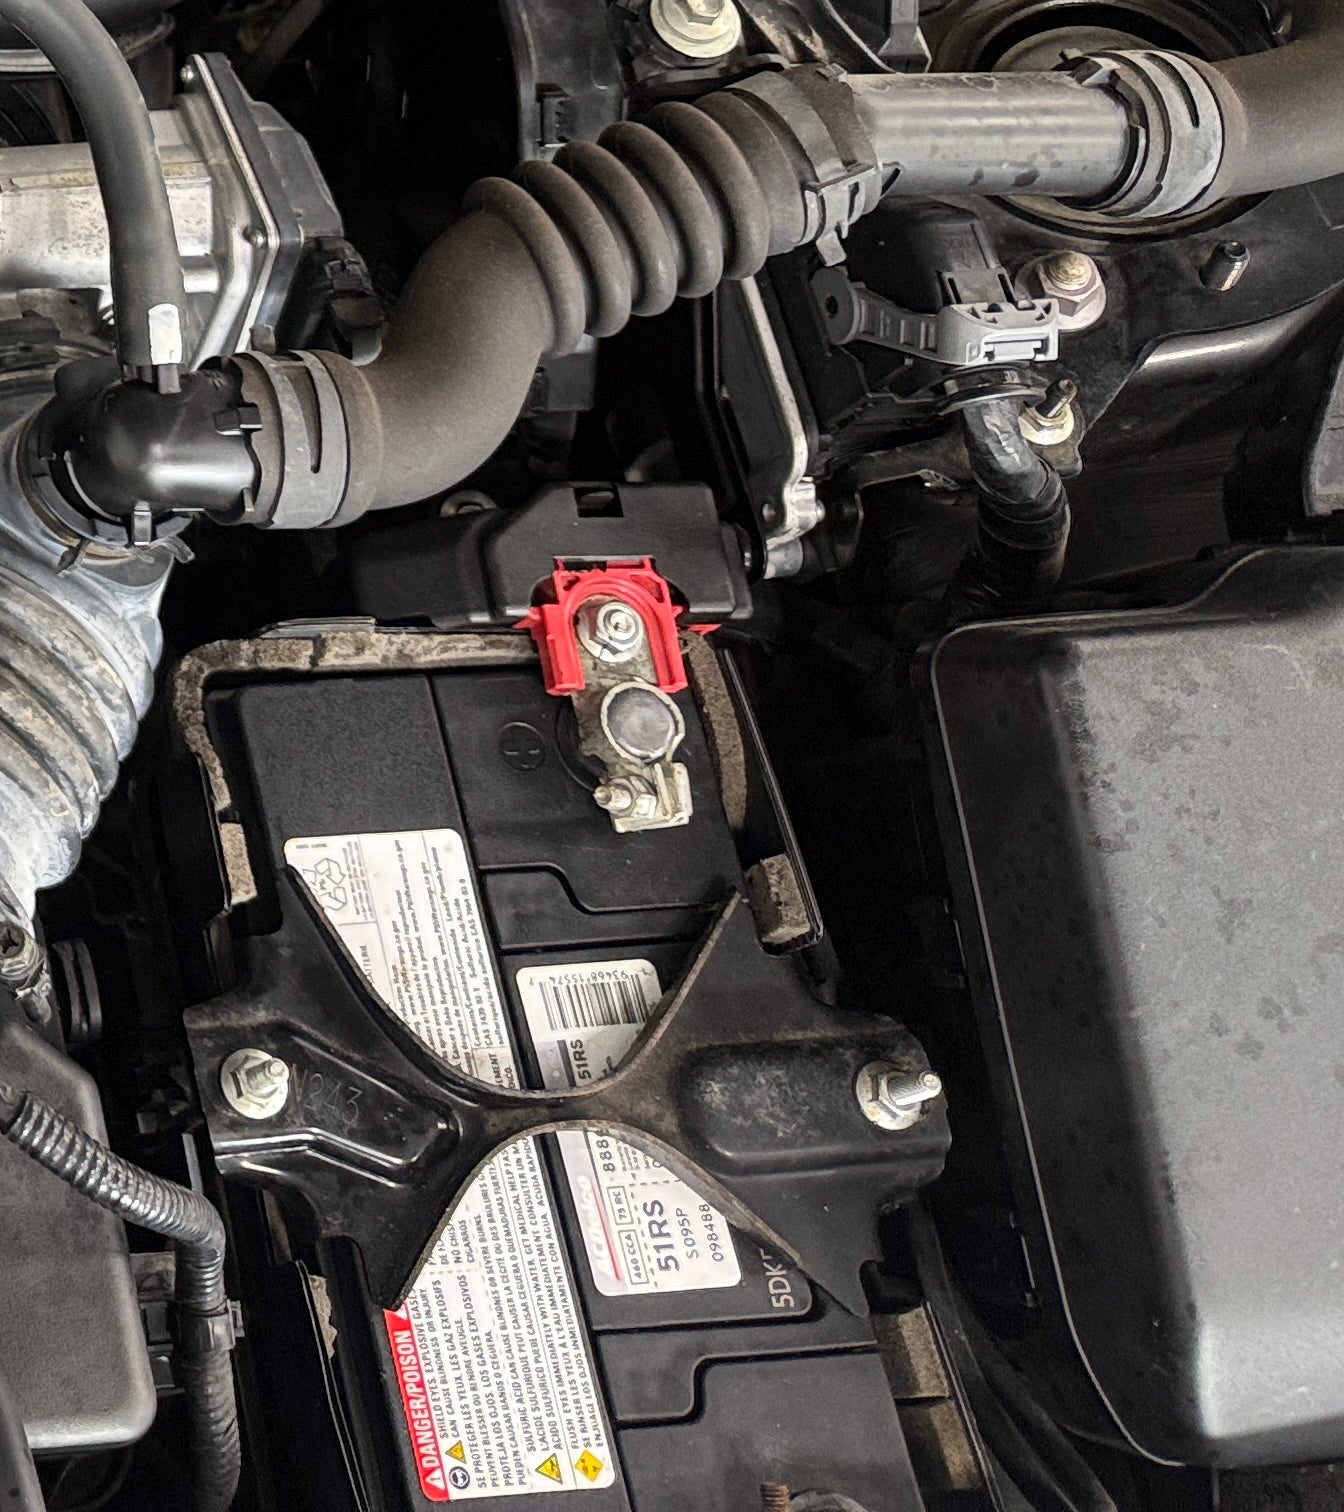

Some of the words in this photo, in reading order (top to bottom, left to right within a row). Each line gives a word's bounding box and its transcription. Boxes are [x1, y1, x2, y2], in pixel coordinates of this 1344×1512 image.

[358, 945, 374, 983] ATTERIE
[570, 1038, 592, 1080] 51RS
[504, 1168, 517, 1191] HELP
[529, 1174, 545, 1206] ACUDA
[510, 1193, 528, 1234] MEDICAL
[517, 1172, 538, 1226] CONSULTER
[457, 1219, 475, 1263] CIGARROS
[623, 1233, 636, 1255] CCA
[641, 1198, 680, 1273] 51RS
[698, 1203, 725, 1263] 098488
[546, 1242, 559, 1262] CON
[457, 1274, 478, 1332] EXPLOSIVOS
[505, 1297, 521, 1329] CAUSER
[519, 1301, 536, 1335] CAUSAR
[534, 1294, 548, 1319] WITH
[414, 1322, 433, 1372] EXPLOSIVE
[471, 1334, 486, 1366] GASES
[500, 1333, 514, 1359] CAUSE
[513, 1331, 526, 1352] PEUT
[542, 1322, 565, 1387] IMMEDIATELY
[448, 1353, 460, 1370] LES
[506, 1361, 519, 1379] CAN
[479, 1369, 491, 1387] LOS
[511, 1381, 525, 1404] ACID
[567, 1378, 579, 1395] LES
[579, 1381, 592, 1399] LOS
[393, 1329, 441, 1468] DANGER/POISON
[441, 1387, 455, 1415] CAUSE
[459, 1403, 472, 1420] LES
[557, 1389, 571, 1413] EYES
[432, 1404, 448, 1439] SHIELD
[448, 1419, 460, 1438] CAN
[474, 1407, 490, 1445] BLESSER
[490, 1420, 503, 1439] LOS
[502, 1412, 518, 1447] CAUSAR
[517, 1406, 536, 1452] SULFURIC
[572, 1397, 588, 1433] RINSER
[564, 1418, 580, 1448] FLUSH
[581, 1436, 592, 1447] SE
[495, 1441, 514, 1486] PROTEJA
[511, 1450, 527, 1485] PUEDEN
[475, 1476, 487, 1488] SE
